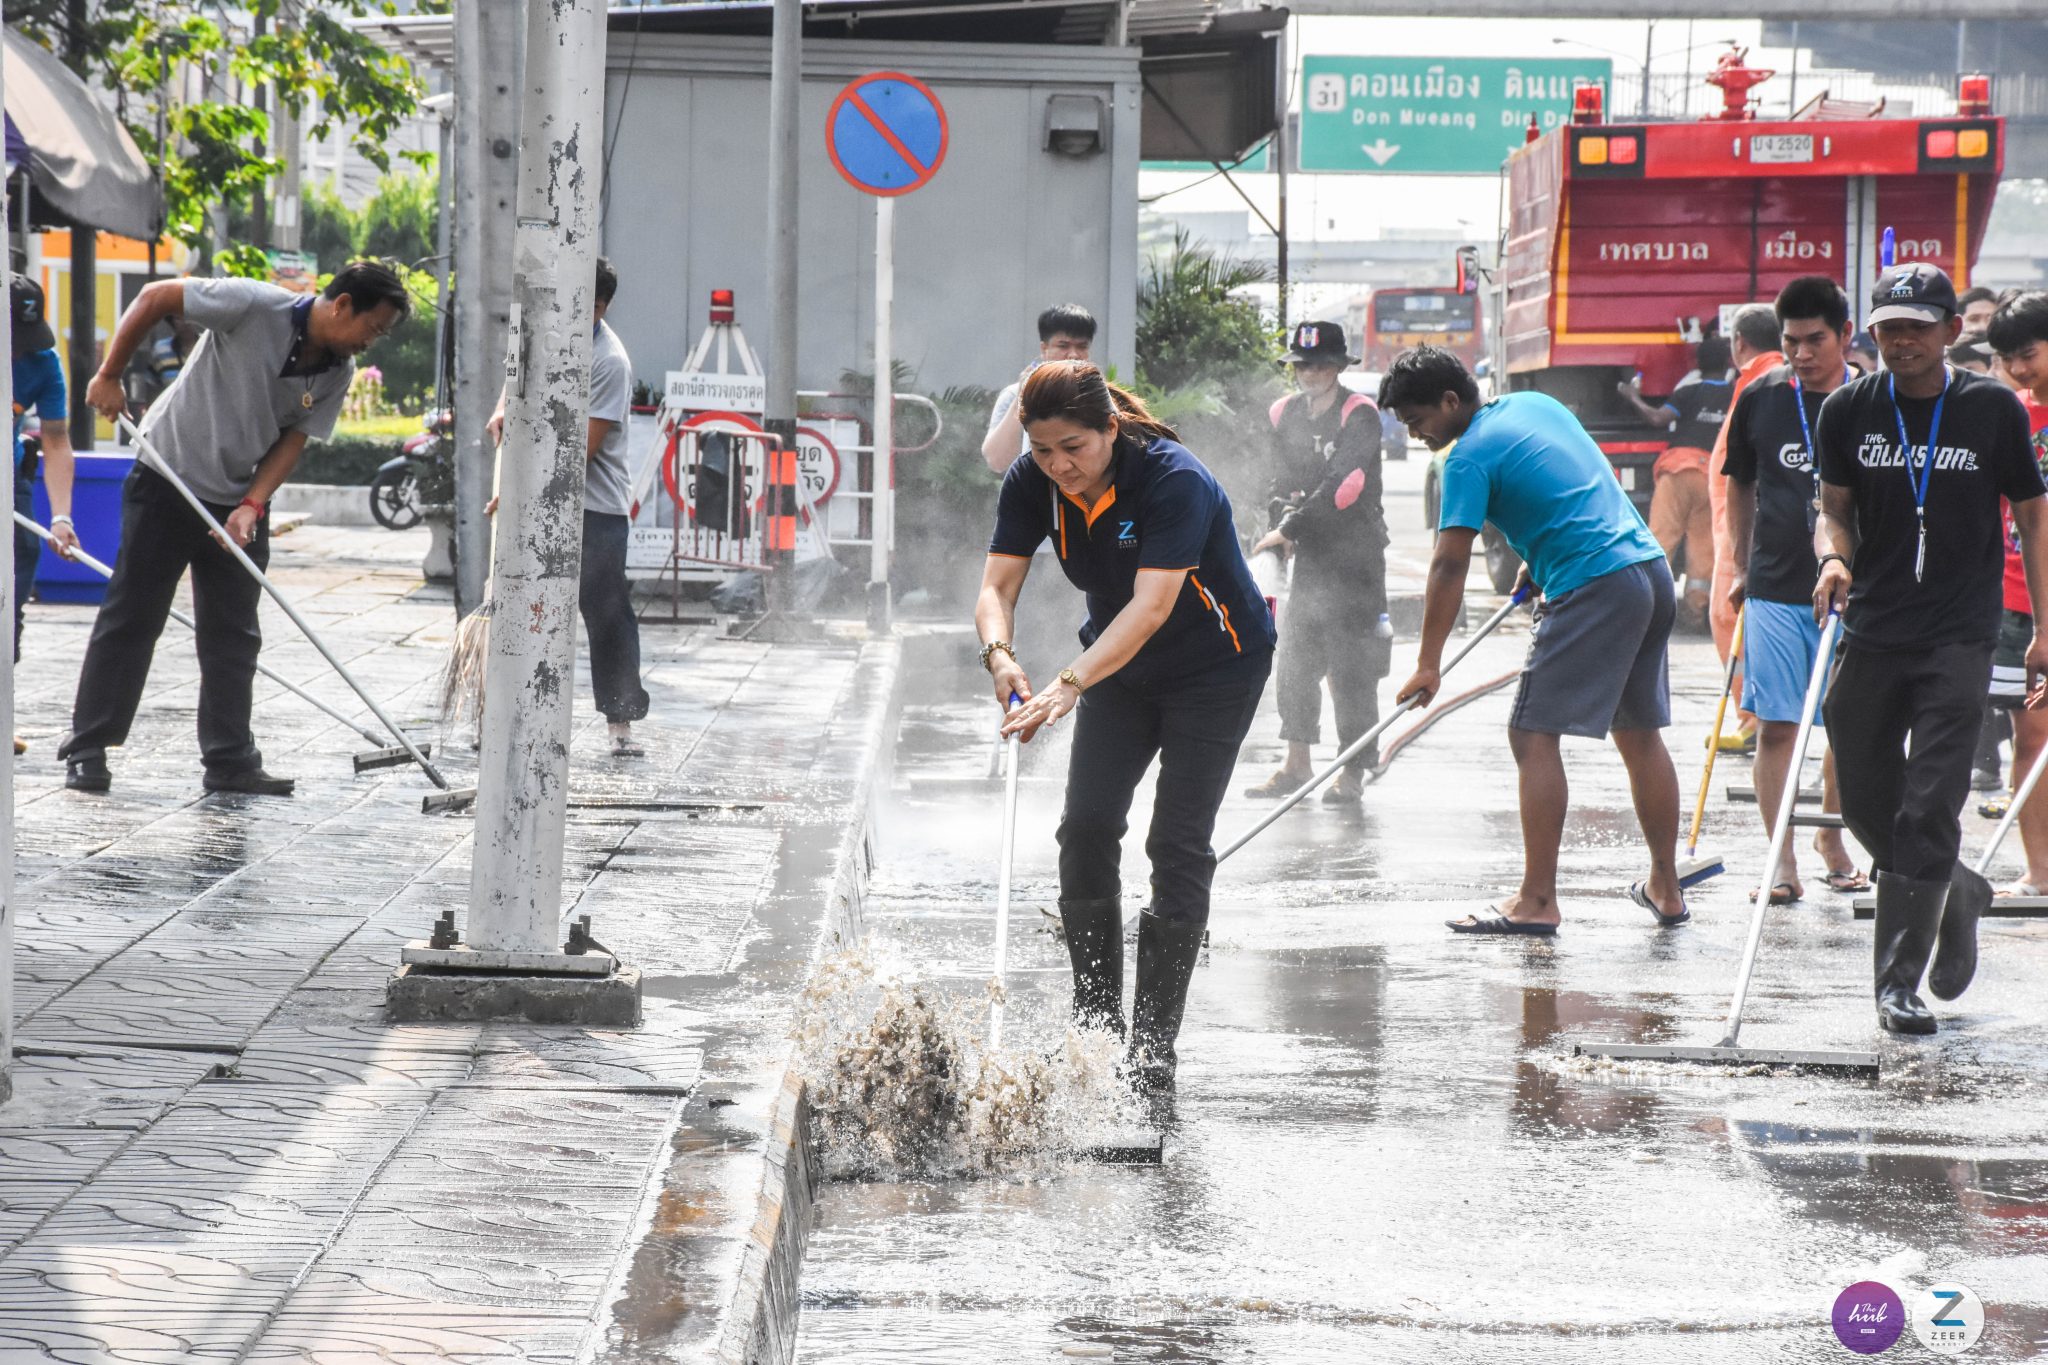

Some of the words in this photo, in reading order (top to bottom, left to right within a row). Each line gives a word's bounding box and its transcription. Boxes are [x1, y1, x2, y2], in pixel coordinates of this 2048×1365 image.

[1350, 65, 1480, 98] ดอนเมือง
[1505, 67, 1605, 99] ดินแ
[1317, 90, 1338, 107] 31
[1352, 108, 1390, 125] Don
[1400, 109, 1476, 130] Mueang
[1600, 242, 1708, 261] เทศบาล
[1765, 230, 1832, 259] เมือง
[671, 376, 764, 407] สถานีตำรวจภูธรคูค
